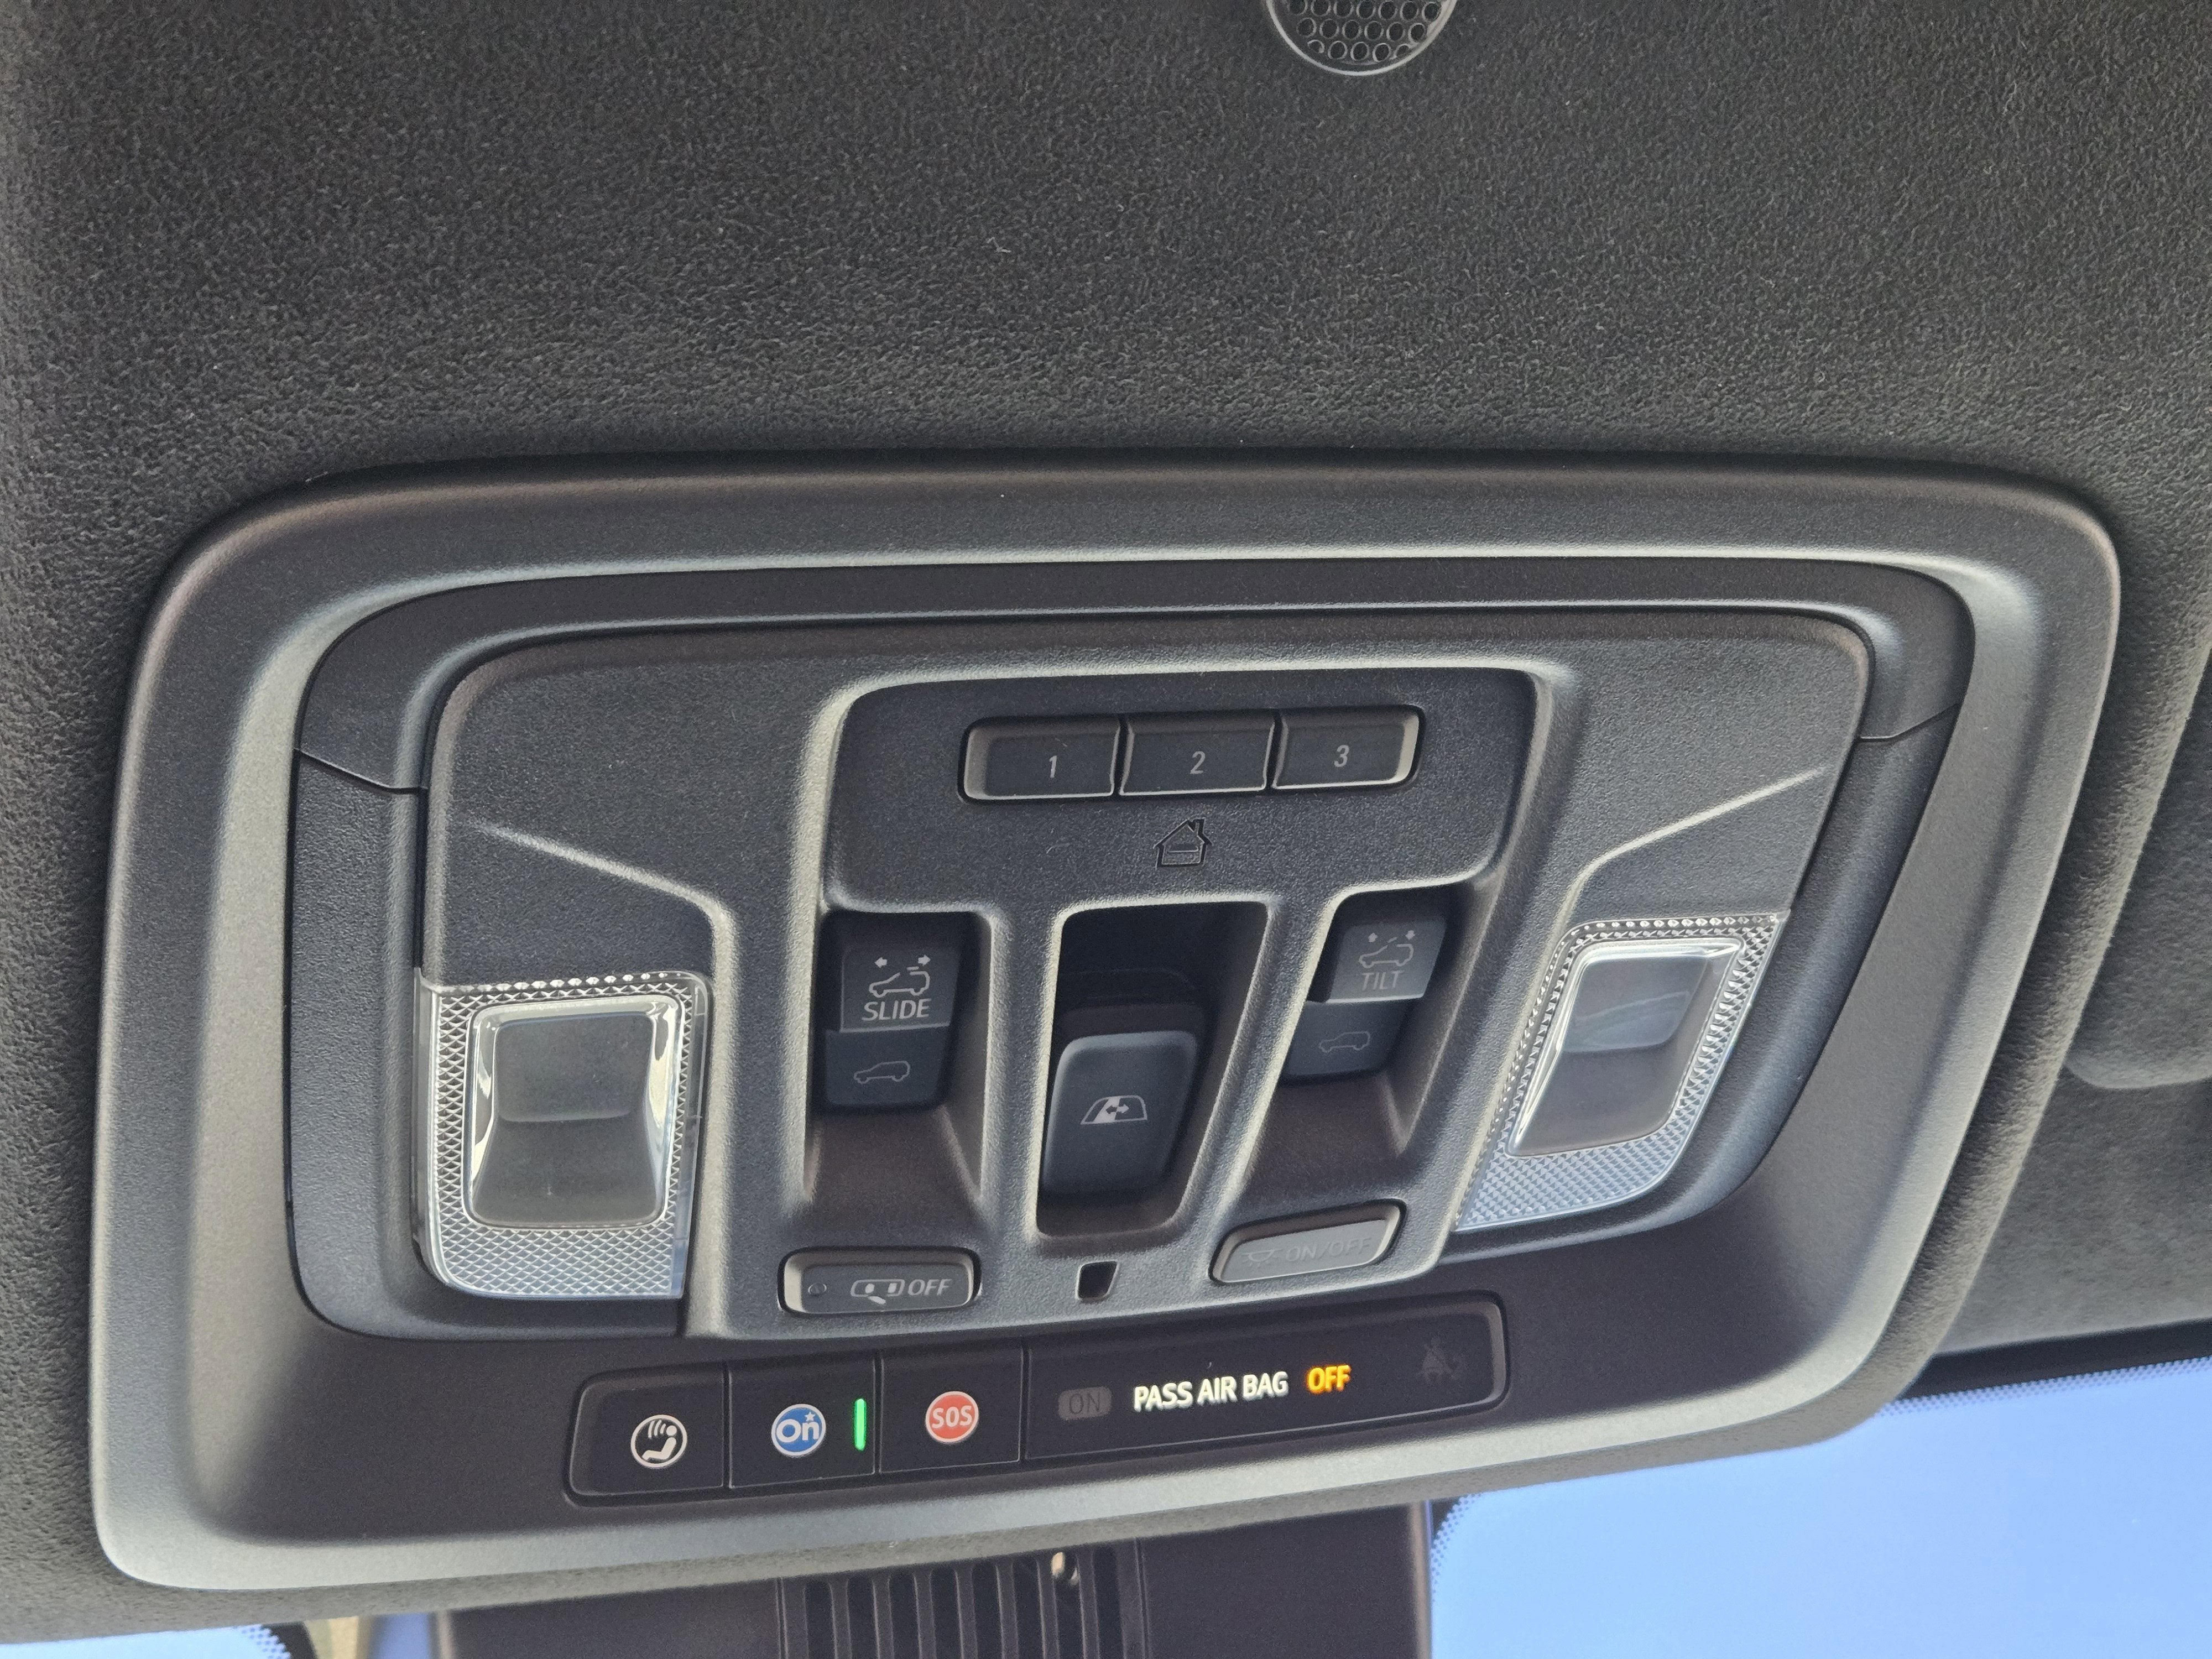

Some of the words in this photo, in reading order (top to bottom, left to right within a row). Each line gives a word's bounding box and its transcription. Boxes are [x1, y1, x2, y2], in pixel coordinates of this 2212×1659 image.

[1049, 755, 1057, 778] 1
[1191, 751, 1206, 774] 2
[1334, 745, 1349, 768] 3
[1362, 971, 1403, 990] TILT
[862, 999, 931, 1021] SLIDE
[1286, 1238, 1371, 1262] ON/OFF
[907, 1279, 952, 1296] OFF
[1068, 1392, 1101, 1414] ON
[1133, 1381, 1193, 1412] PASS
[1197, 1376, 1238, 1406] AIR
[1243, 1371, 1288, 1401] BAG
[1307, 1365, 1351, 1394] OFF
[932, 1405, 972, 1430] SOS
